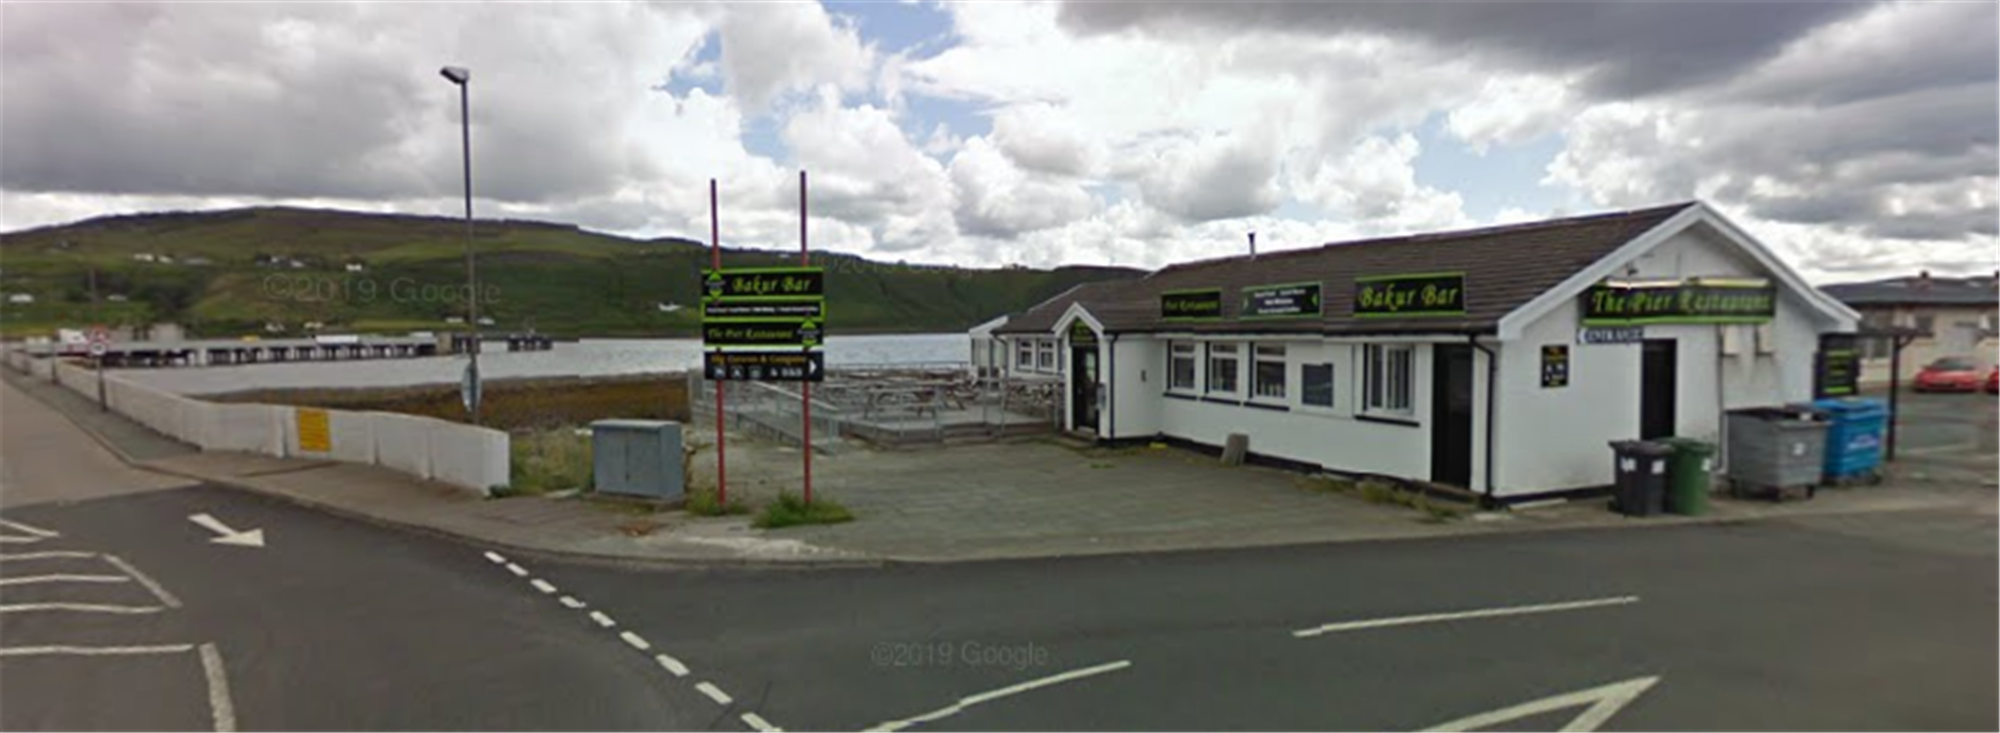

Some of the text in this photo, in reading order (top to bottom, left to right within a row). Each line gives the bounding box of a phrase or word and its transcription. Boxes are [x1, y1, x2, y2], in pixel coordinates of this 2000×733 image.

[732, 275, 812, 295] Bakur Bar
[1359, 283, 1458, 310] Bakur Bar
[1593, 290, 1770, 313] The Pier Restaurant
